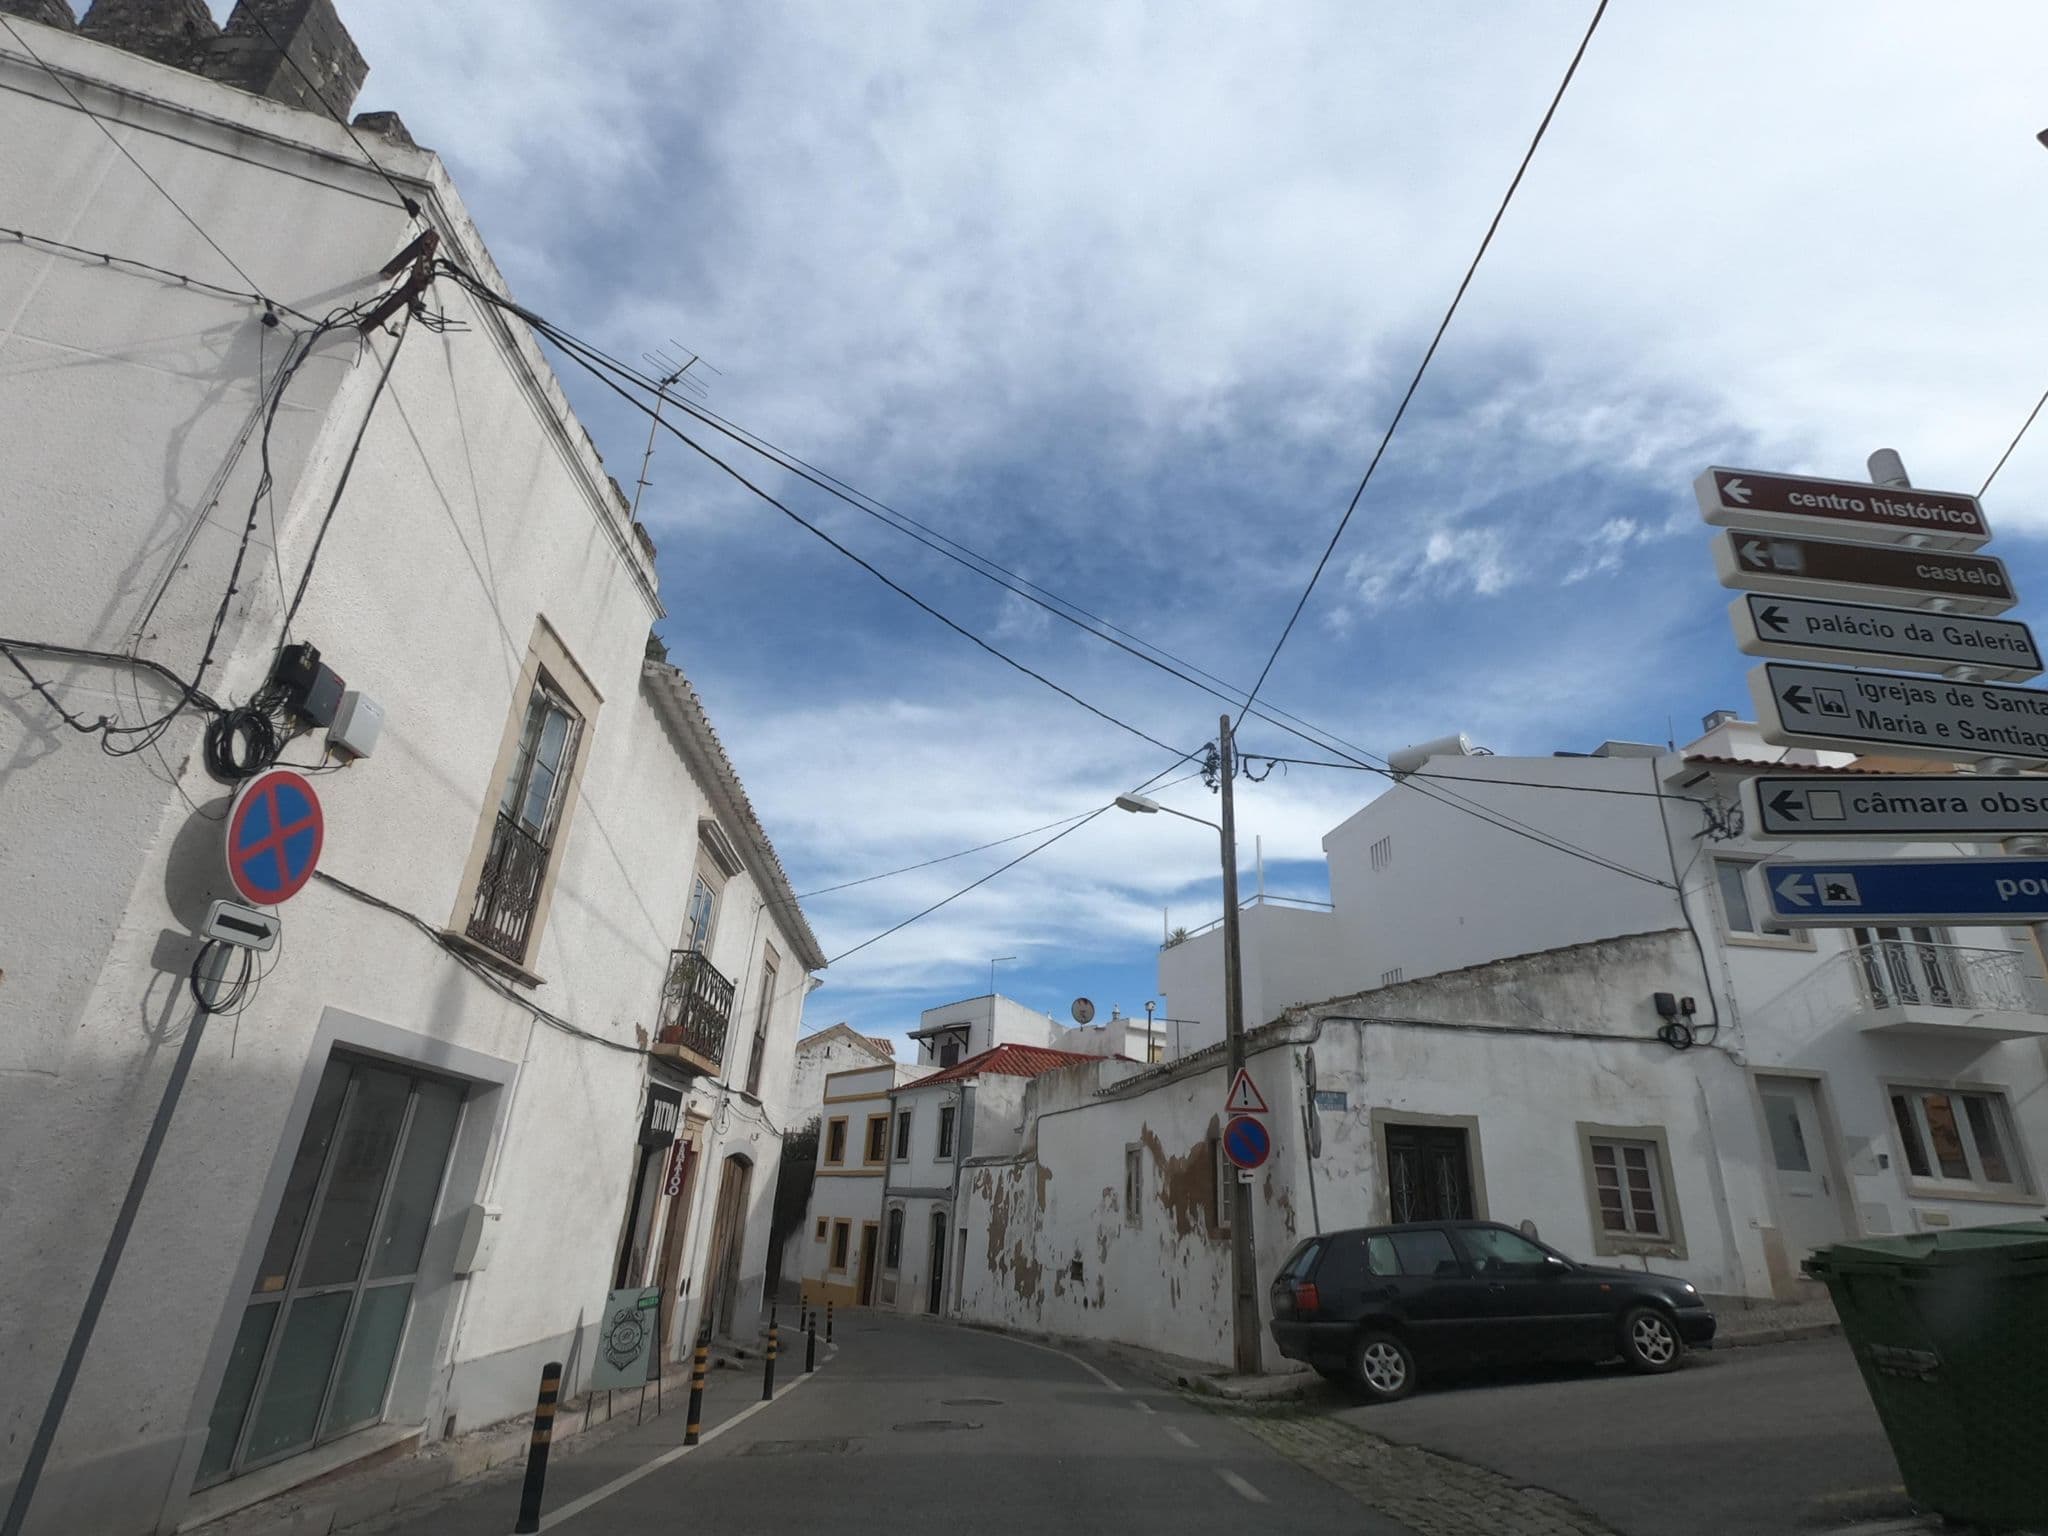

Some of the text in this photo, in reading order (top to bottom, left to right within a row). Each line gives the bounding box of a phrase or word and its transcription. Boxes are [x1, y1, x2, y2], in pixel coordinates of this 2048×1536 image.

[1788, 491, 1976, 526] centro histórico
[1916, 562, 2001, 587] castelo
[1806, 613, 2030, 653] palácio da Galeria
[1855, 678, 2048, 716] igrejas de Santa
[1855, 709, 1927, 736] Maria
[1936, 722, 1950, 737] e
[1853, 792, 1968, 814] câmara
